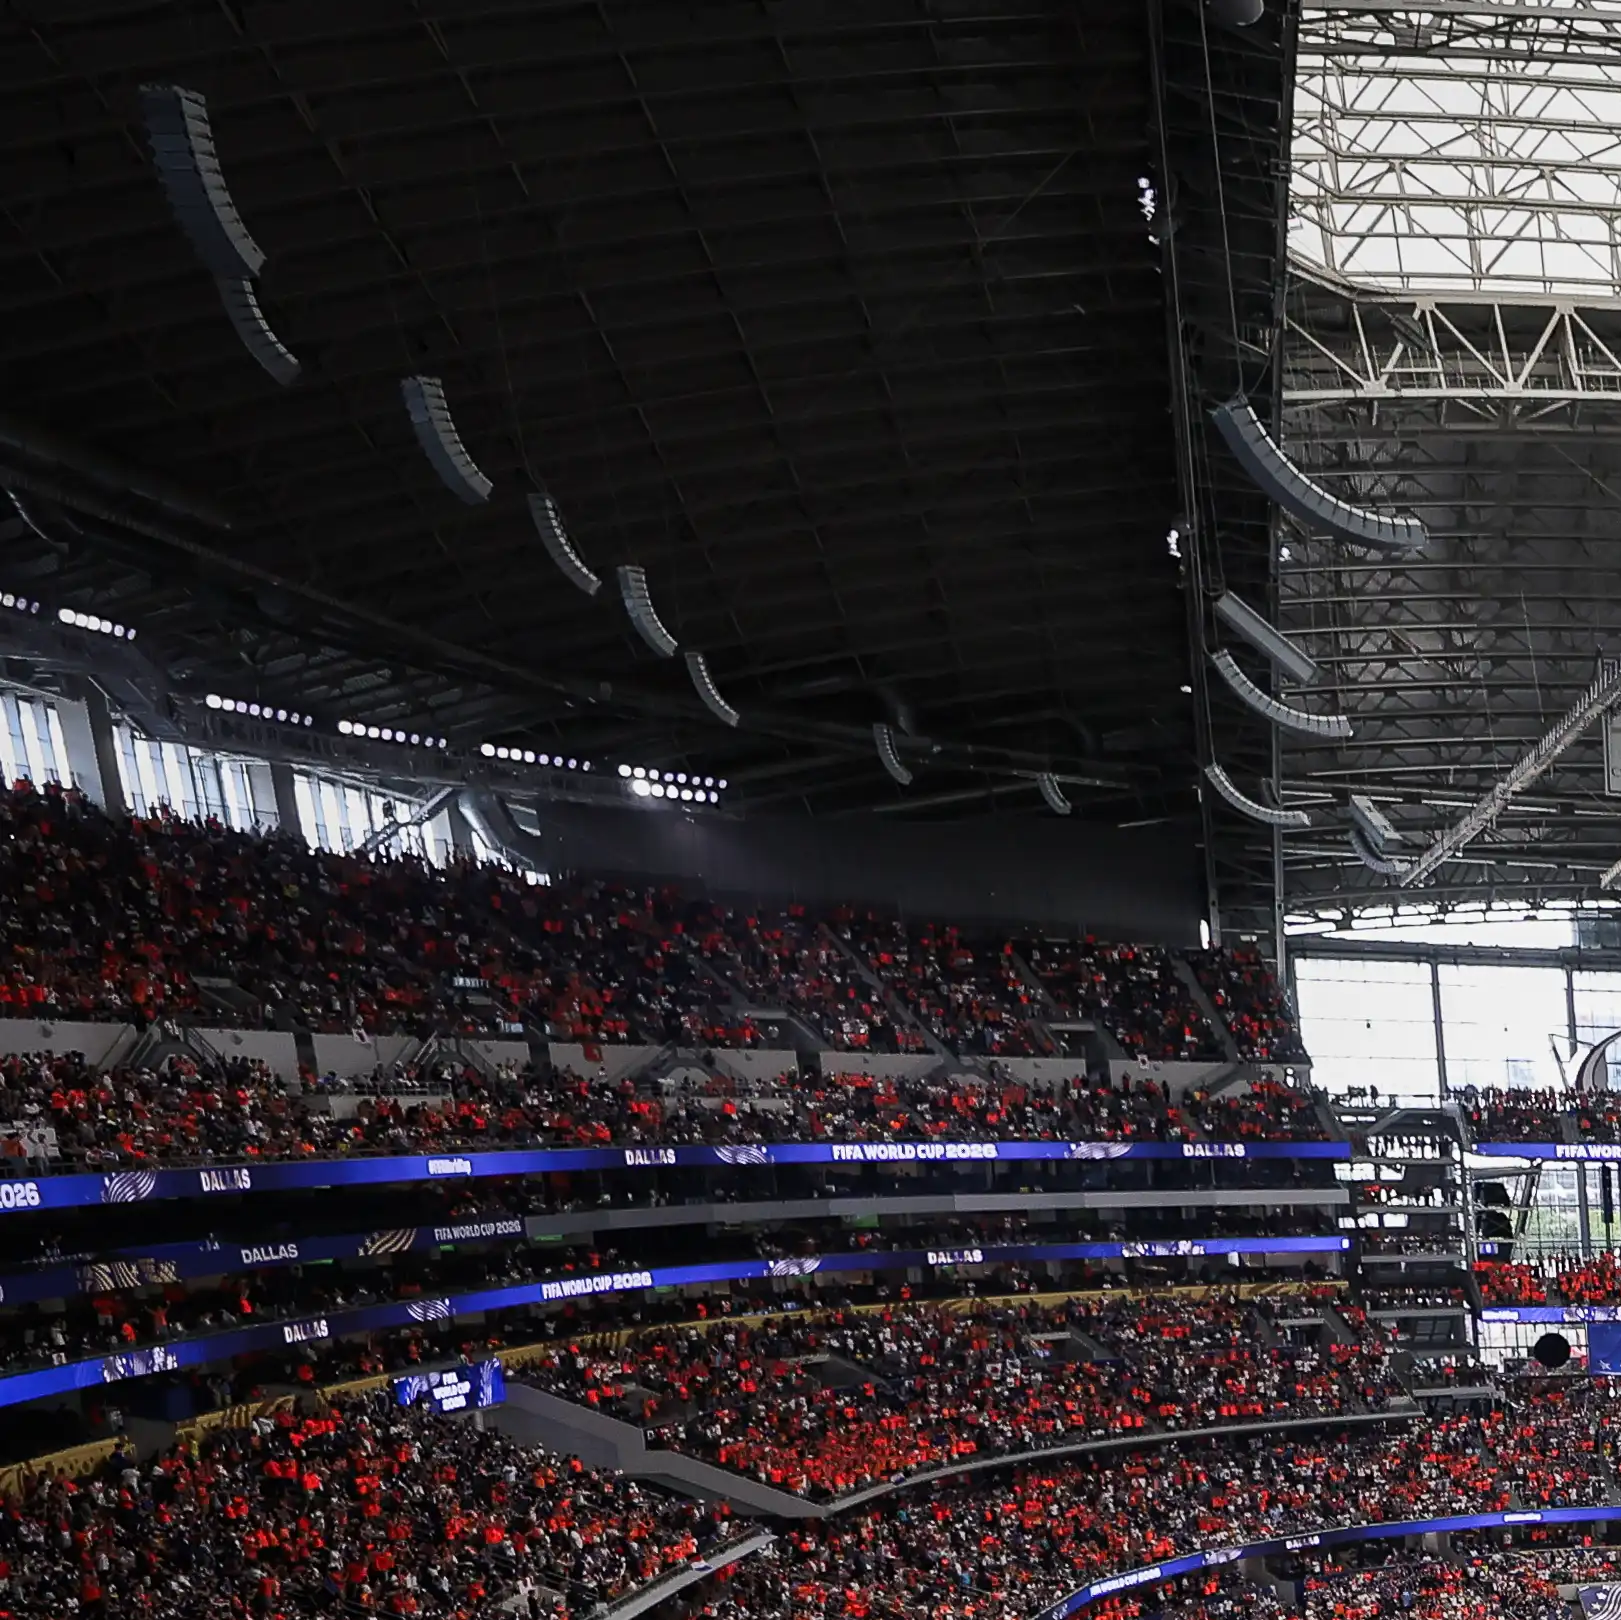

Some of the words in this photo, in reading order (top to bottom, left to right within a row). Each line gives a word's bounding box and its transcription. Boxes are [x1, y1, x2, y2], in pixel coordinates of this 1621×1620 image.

[625, 1148, 676, 1166] DALLAS
[832, 1144, 864, 1161] FIFA
[864, 1143, 916, 1160] WORLD
[916, 1143, 944, 1159] CUP
[946, 1143, 998, 1159] 2026
[1182, 1143, 1246, 1158] DALLAS
[1555, 1144, 1587, 1158] FIFA
[200, 1168, 251, 1192] DALLAS
[434, 1227, 454, 1241] FIFA
[454, 1224, 480, 1239] WORLD
[480, 1222, 496, 1237] CUP
[496, 1219, 522, 1235] 2026
[241, 1243, 298, 1264] DALLAS
[927, 1249, 983, 1265] DALLAS
[541, 1280, 563, 1300] FIFA
[563, 1277, 591, 1297] WORLD
[591, 1274, 612, 1293] CUP
[612, 1271, 653, 1290] 2026
[283, 1319, 329, 1344] DALLAS
